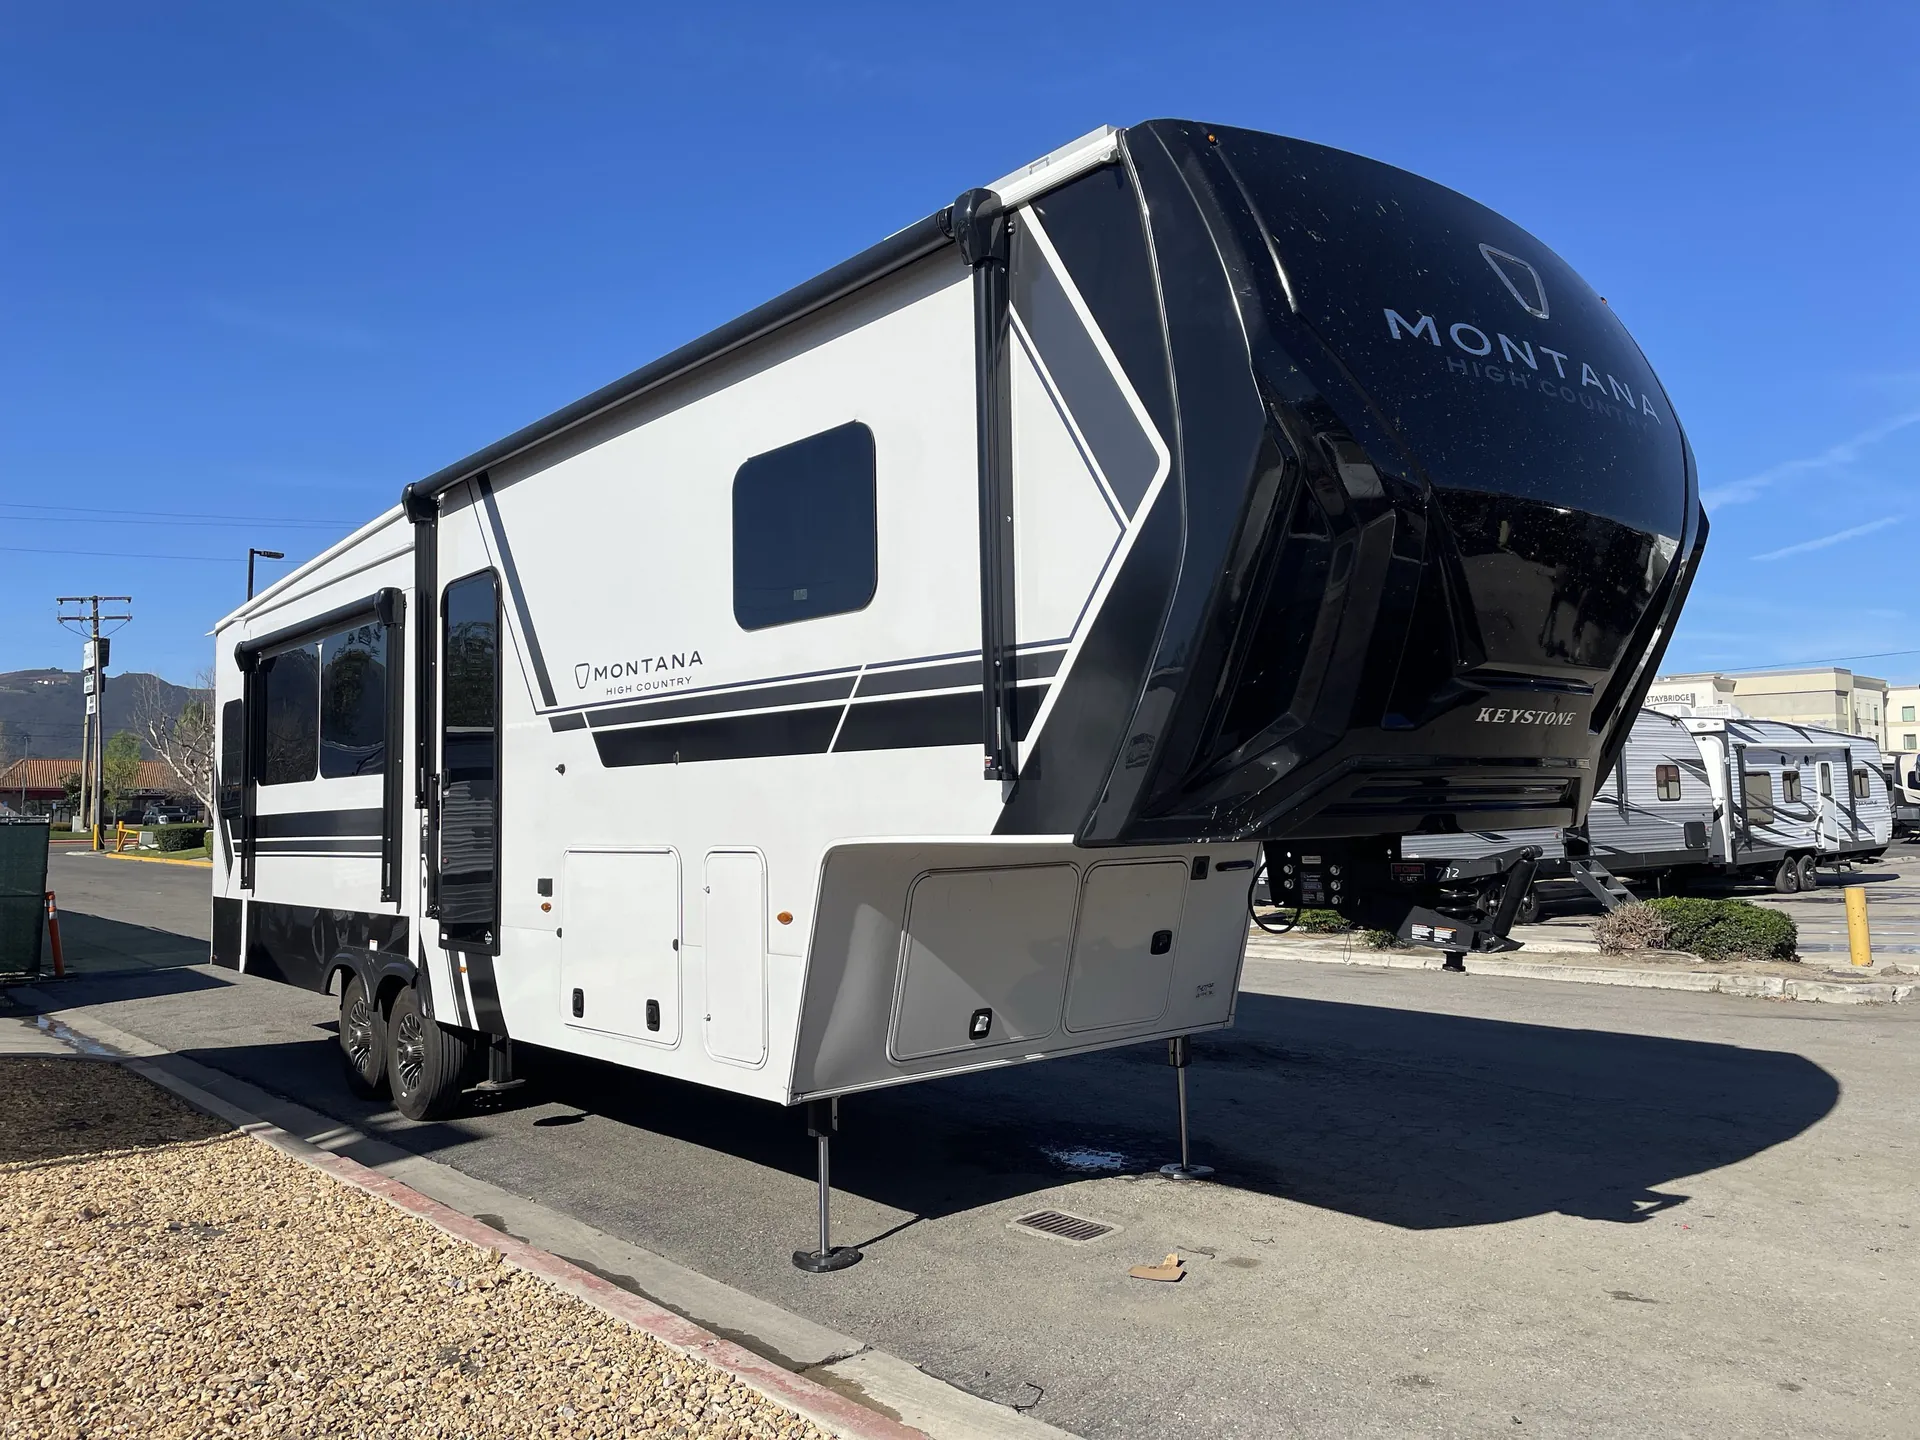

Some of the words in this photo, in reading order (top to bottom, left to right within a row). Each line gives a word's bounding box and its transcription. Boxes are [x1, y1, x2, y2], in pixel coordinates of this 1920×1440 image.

[1383, 308, 1662, 425] MONTANA
[1446, 356, 1529, 389] HIGH
[1540, 380, 1648, 433] COUNTRY
[594, 650, 703, 681] MONTANA
[606, 684, 632, 696] HIGH
[636, 676, 692, 692] COUNTRY
[1646, 693, 1691, 704] STAYBRIDGE
[1475, 707, 1577, 726] KEYSTONE
